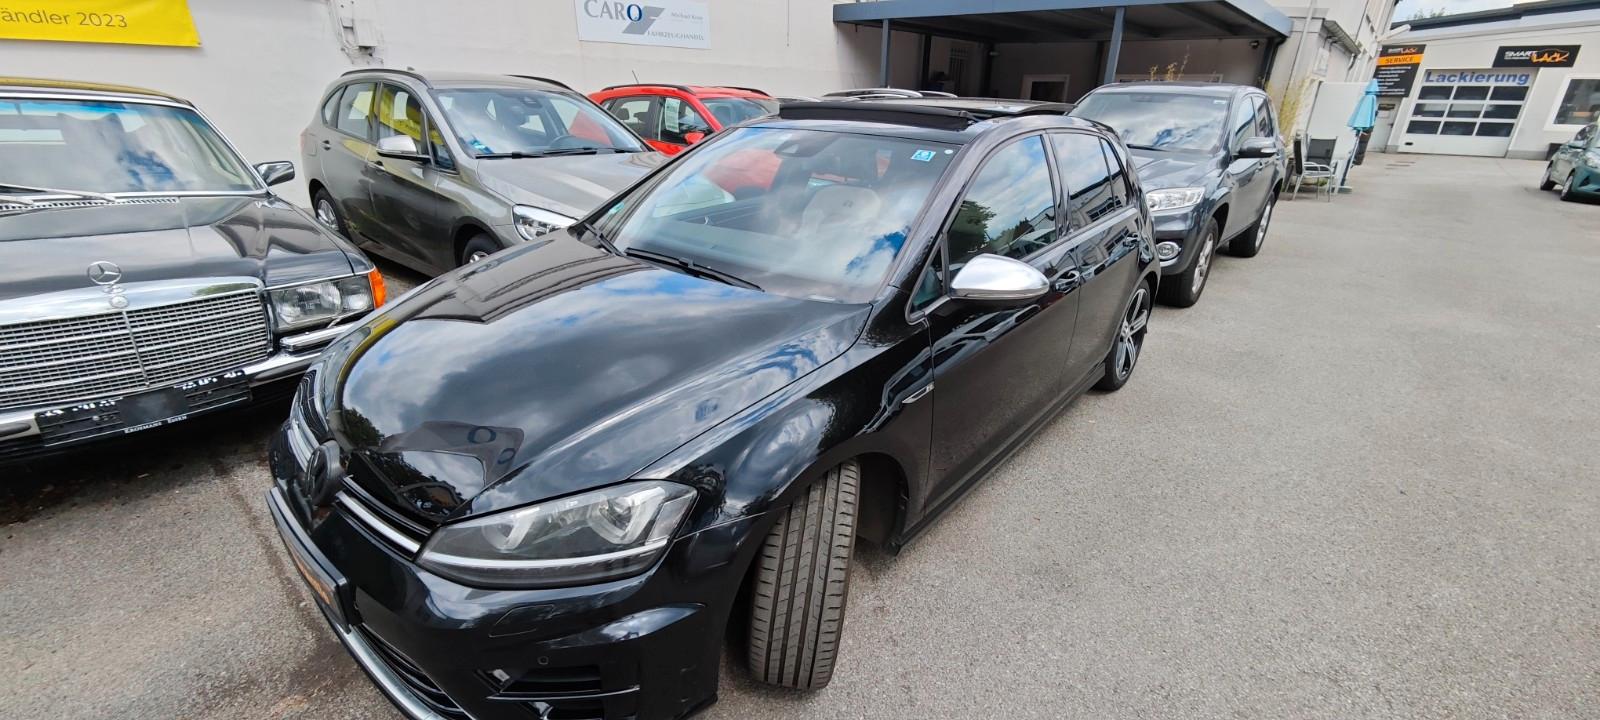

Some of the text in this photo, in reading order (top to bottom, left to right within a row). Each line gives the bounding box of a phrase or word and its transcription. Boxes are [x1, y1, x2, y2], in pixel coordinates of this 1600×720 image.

[583, 0, 643, 22] CARO
[76, 12, 128, 28] 2023
[1384, 56, 1414, 64] SERVICE
[1530, 52, 1569, 63] LACK
[1424, 71, 1530, 86] Lackierung
